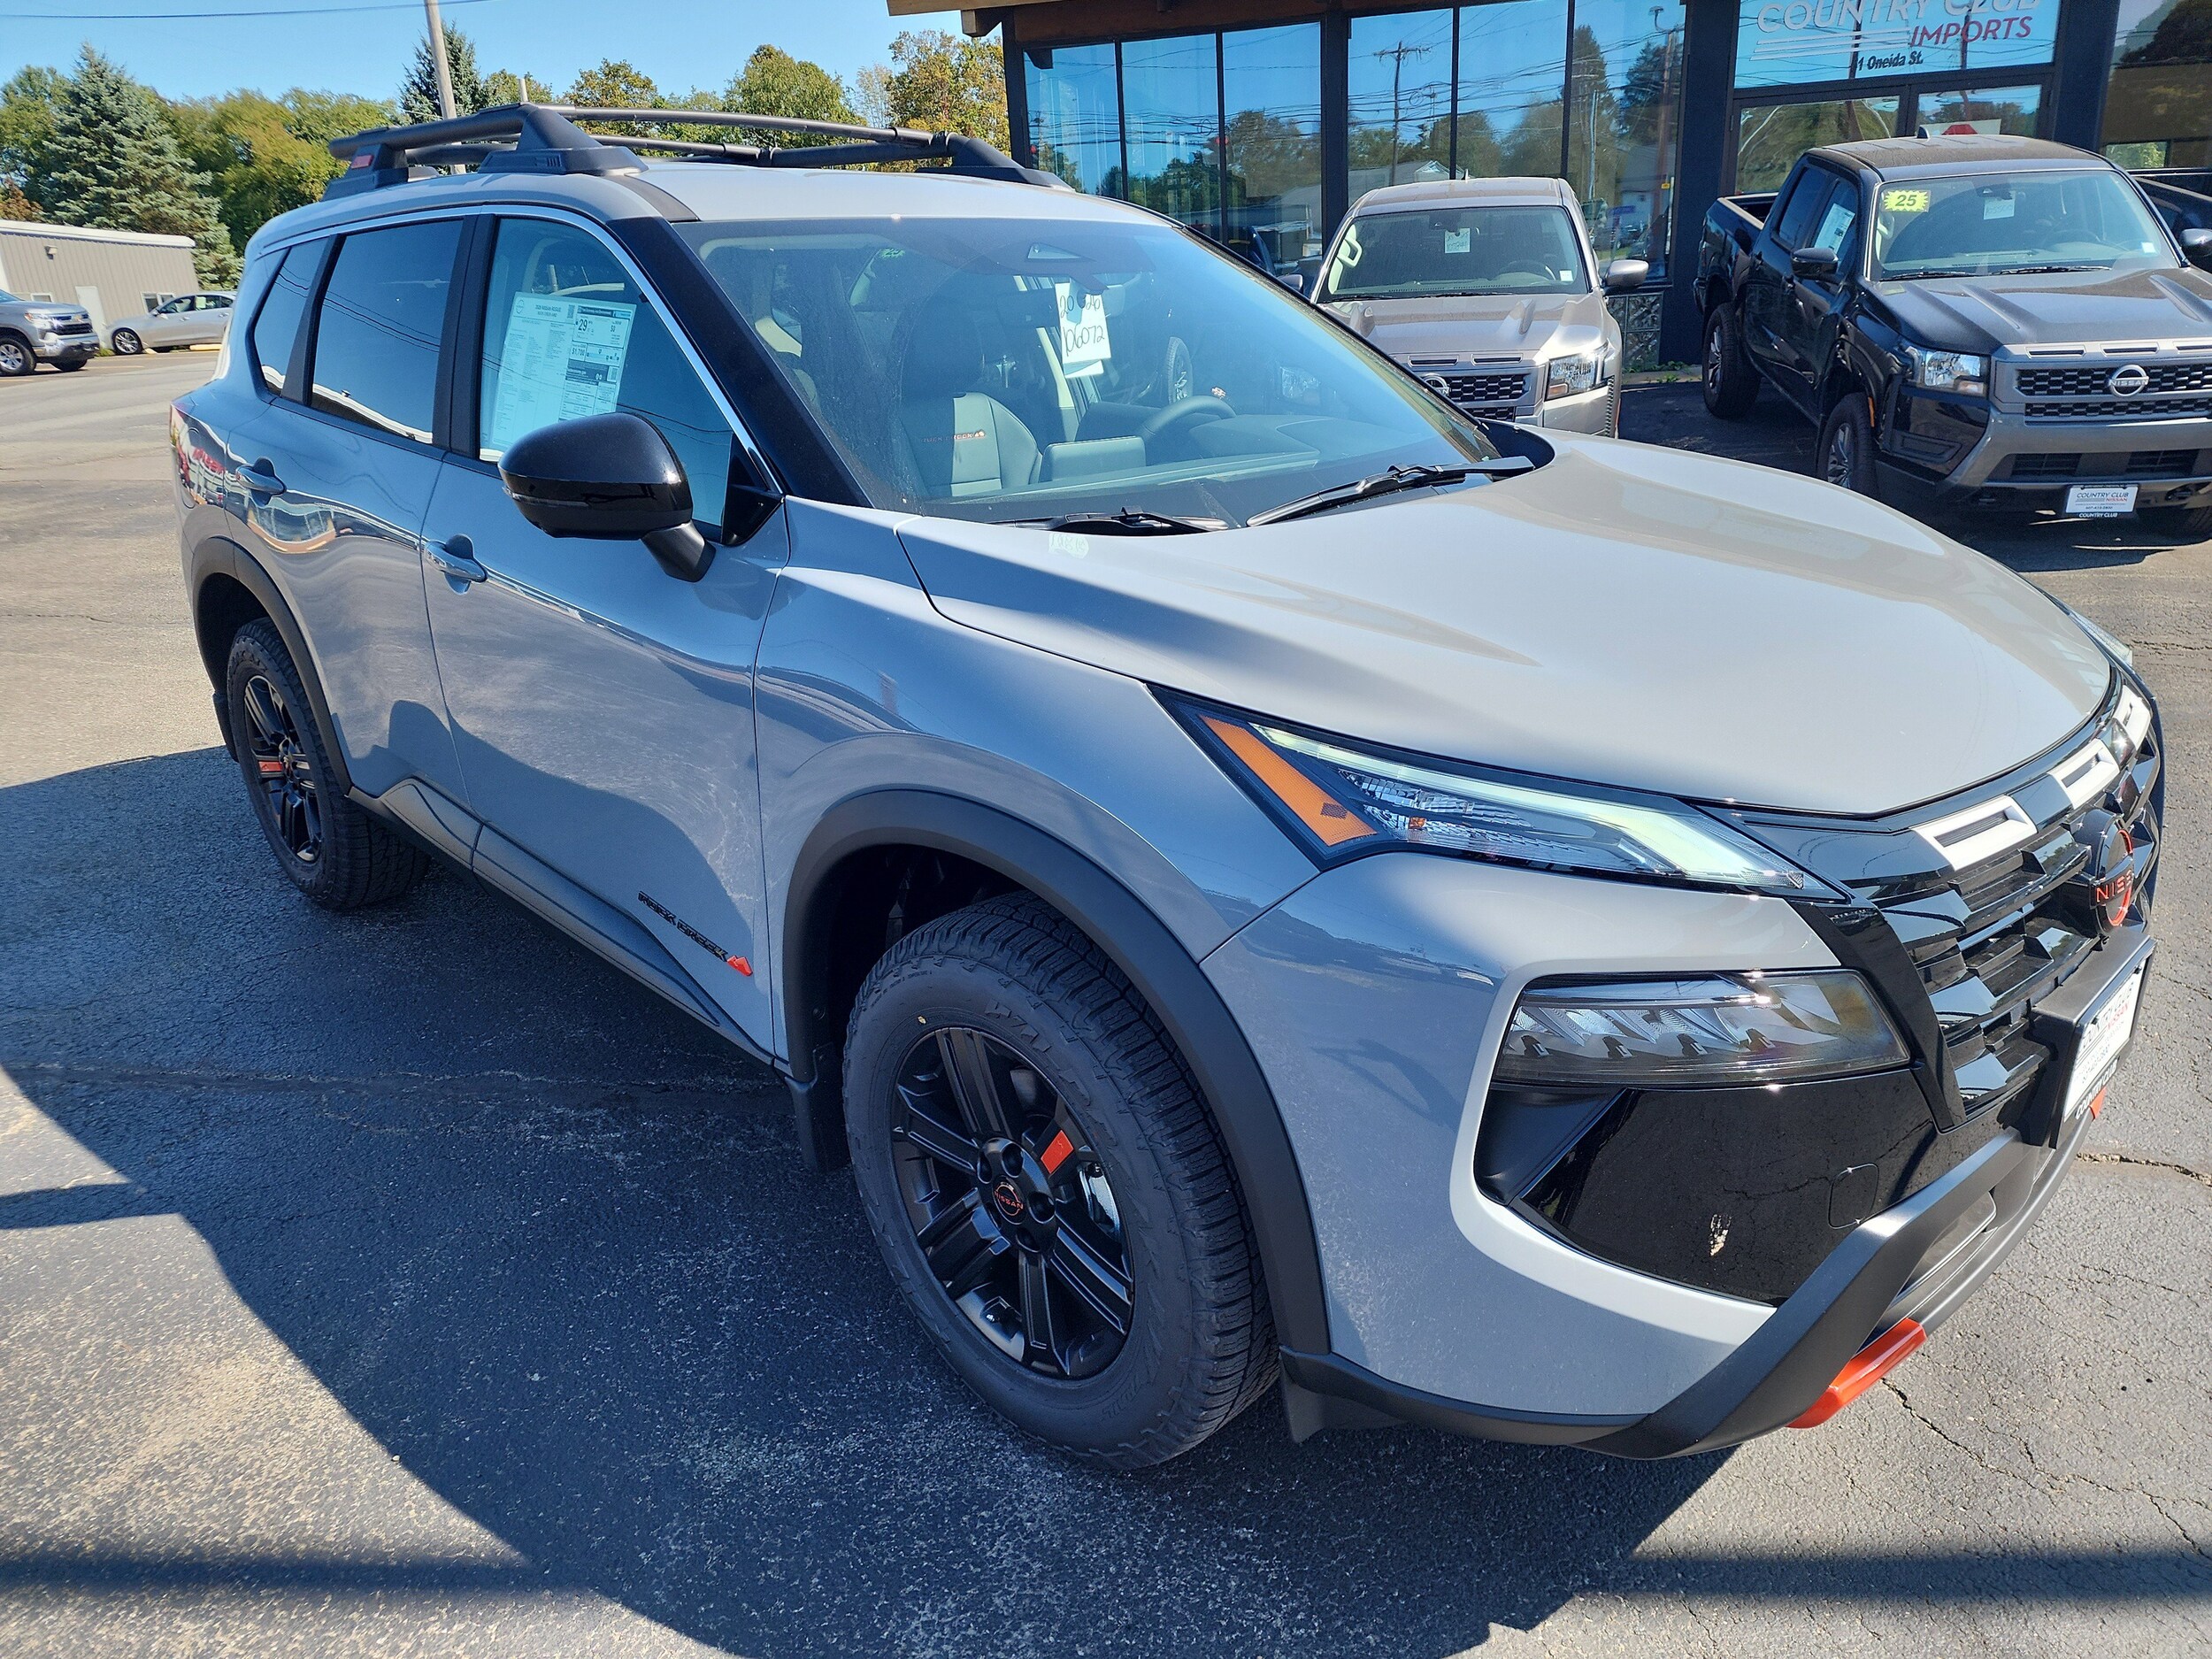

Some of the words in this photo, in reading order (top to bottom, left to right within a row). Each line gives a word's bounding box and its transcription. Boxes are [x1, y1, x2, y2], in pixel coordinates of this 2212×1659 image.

[1757, 0, 1929, 33] COUNTRY
[1910, 16, 2033, 47] IMPORTS
[1867, 53, 1906, 71] Oneida
[1895, 194, 1917, 207] 25
[1063, 325, 1105, 357] 106072
[2108, 376, 2149, 387] NISSAN
[677, 919, 728, 963] CREEK
[2102, 1058, 2118, 1087] CLUB
[994, 1190, 1024, 1210] NISSAN
